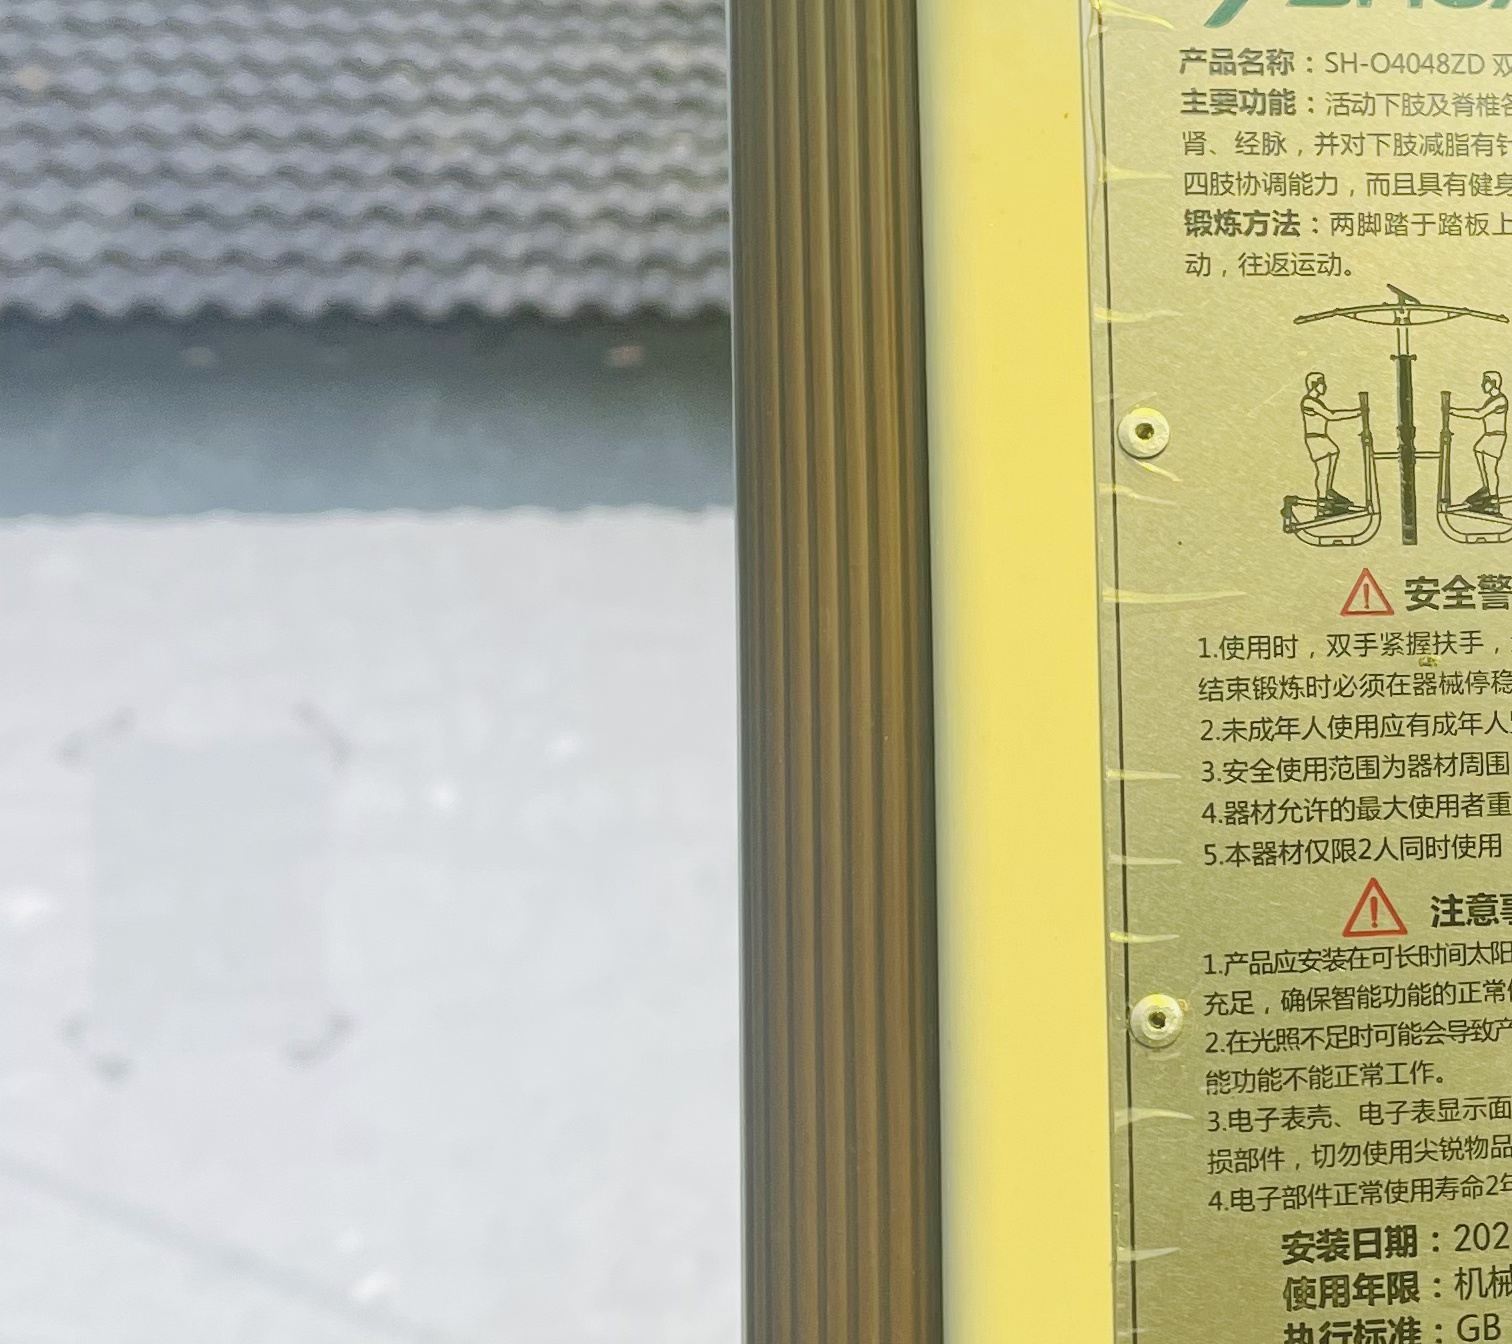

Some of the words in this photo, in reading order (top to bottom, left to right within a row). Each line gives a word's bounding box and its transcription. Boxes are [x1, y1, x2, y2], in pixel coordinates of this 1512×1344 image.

[1186, 251, 1354, 278] 动，往返运动。
[1206, 1059, 1447, 1095] 能功能不能正常工作。
